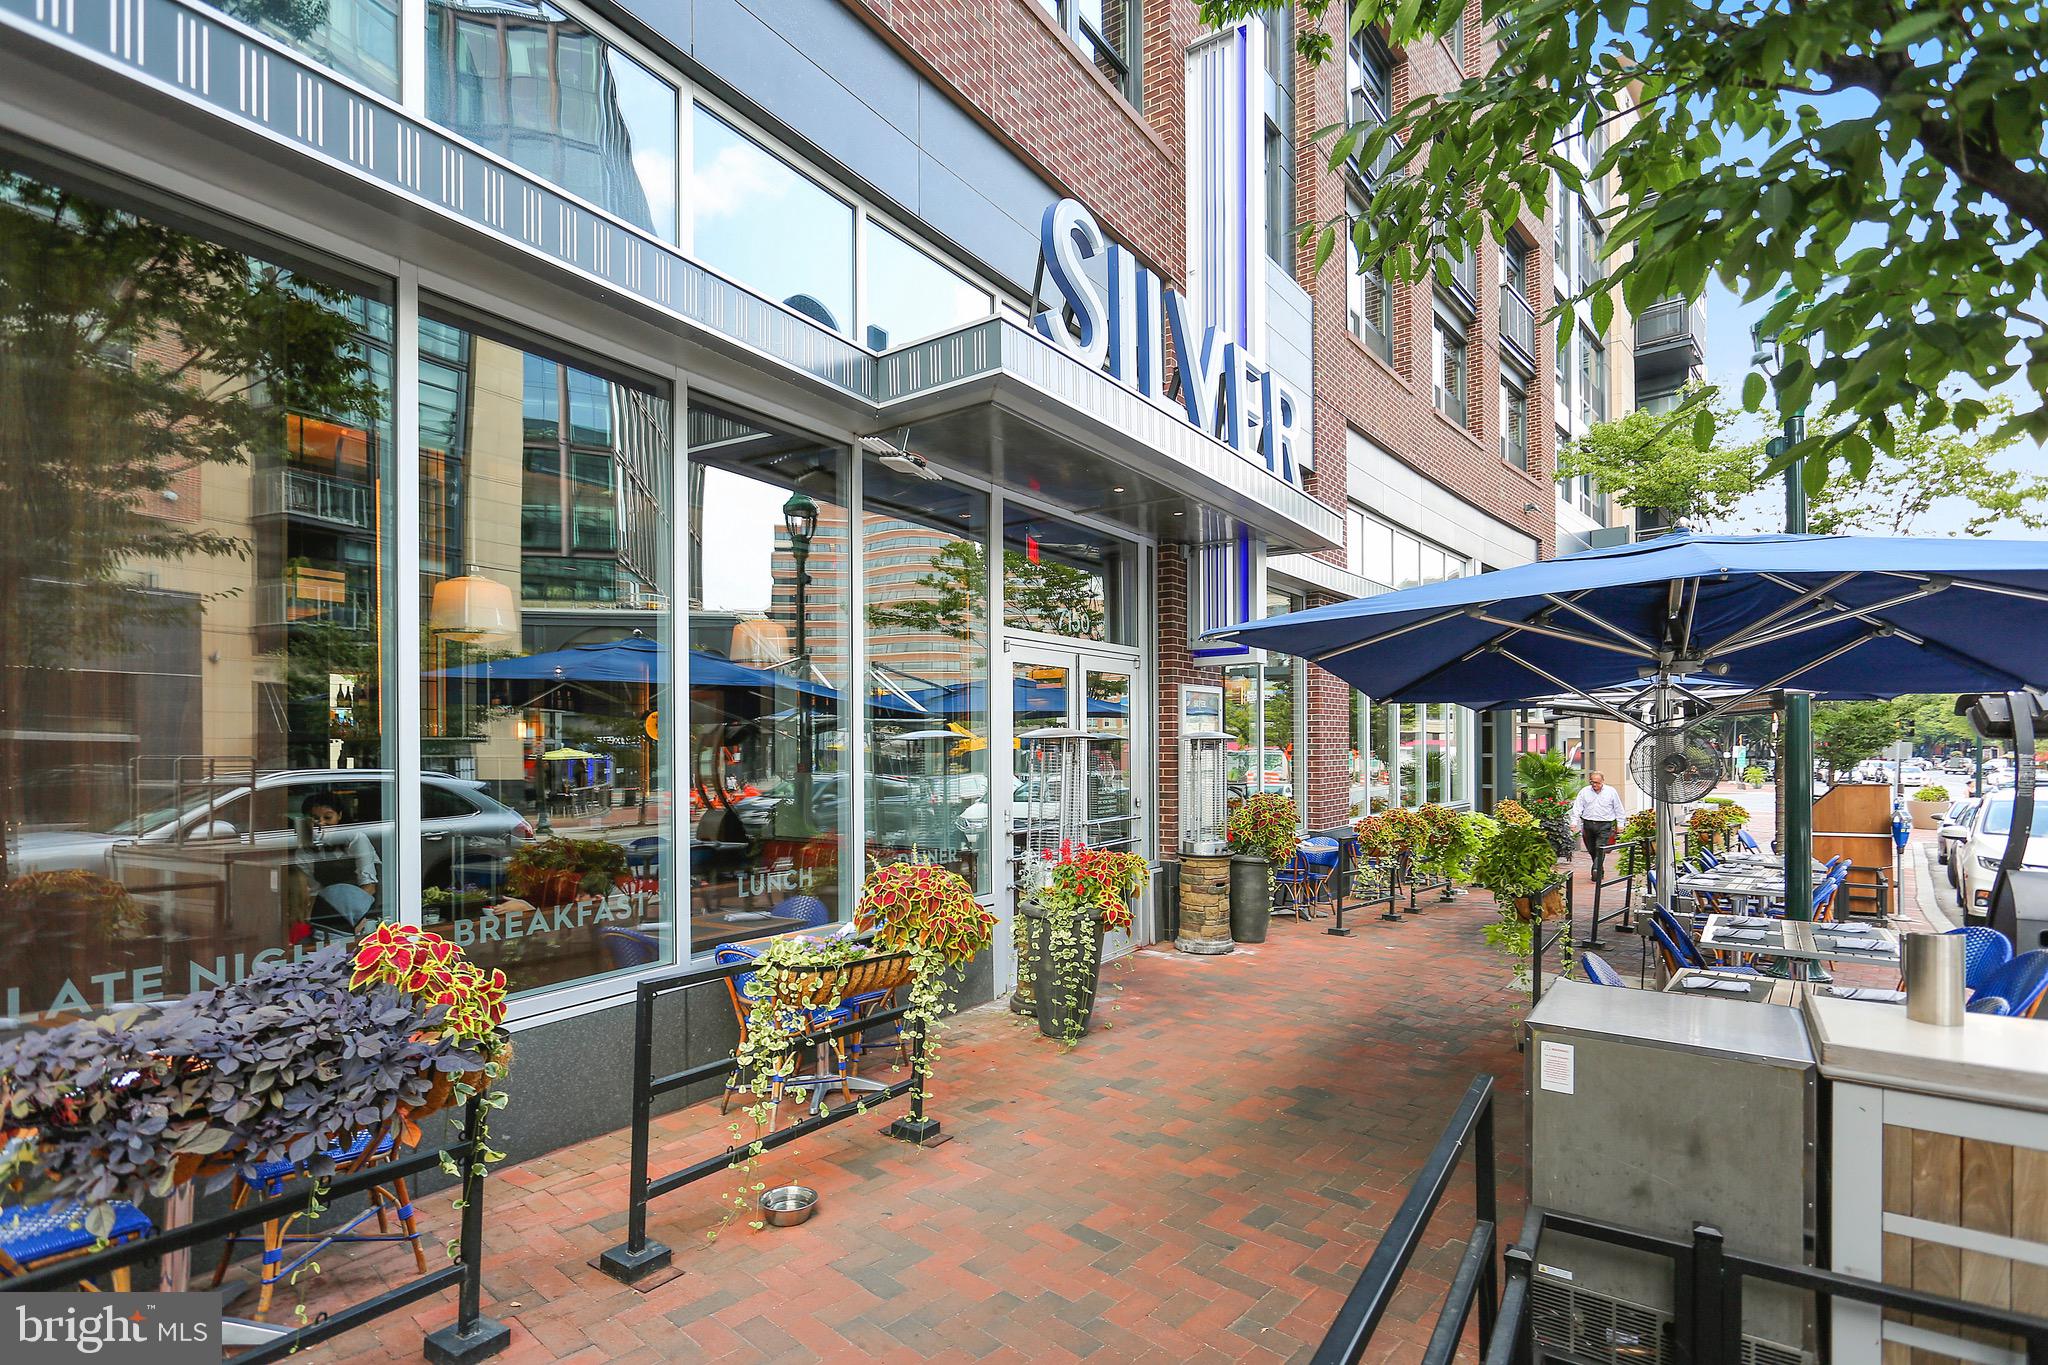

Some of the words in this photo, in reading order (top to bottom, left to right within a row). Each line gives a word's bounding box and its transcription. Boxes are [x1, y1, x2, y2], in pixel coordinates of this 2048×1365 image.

[1034, 197, 1304, 492] SILVER
[738, 866, 814, 898] LUNCH
[453, 892, 646, 947] BREAKFAST
[7, 965, 164, 1023] LATE
